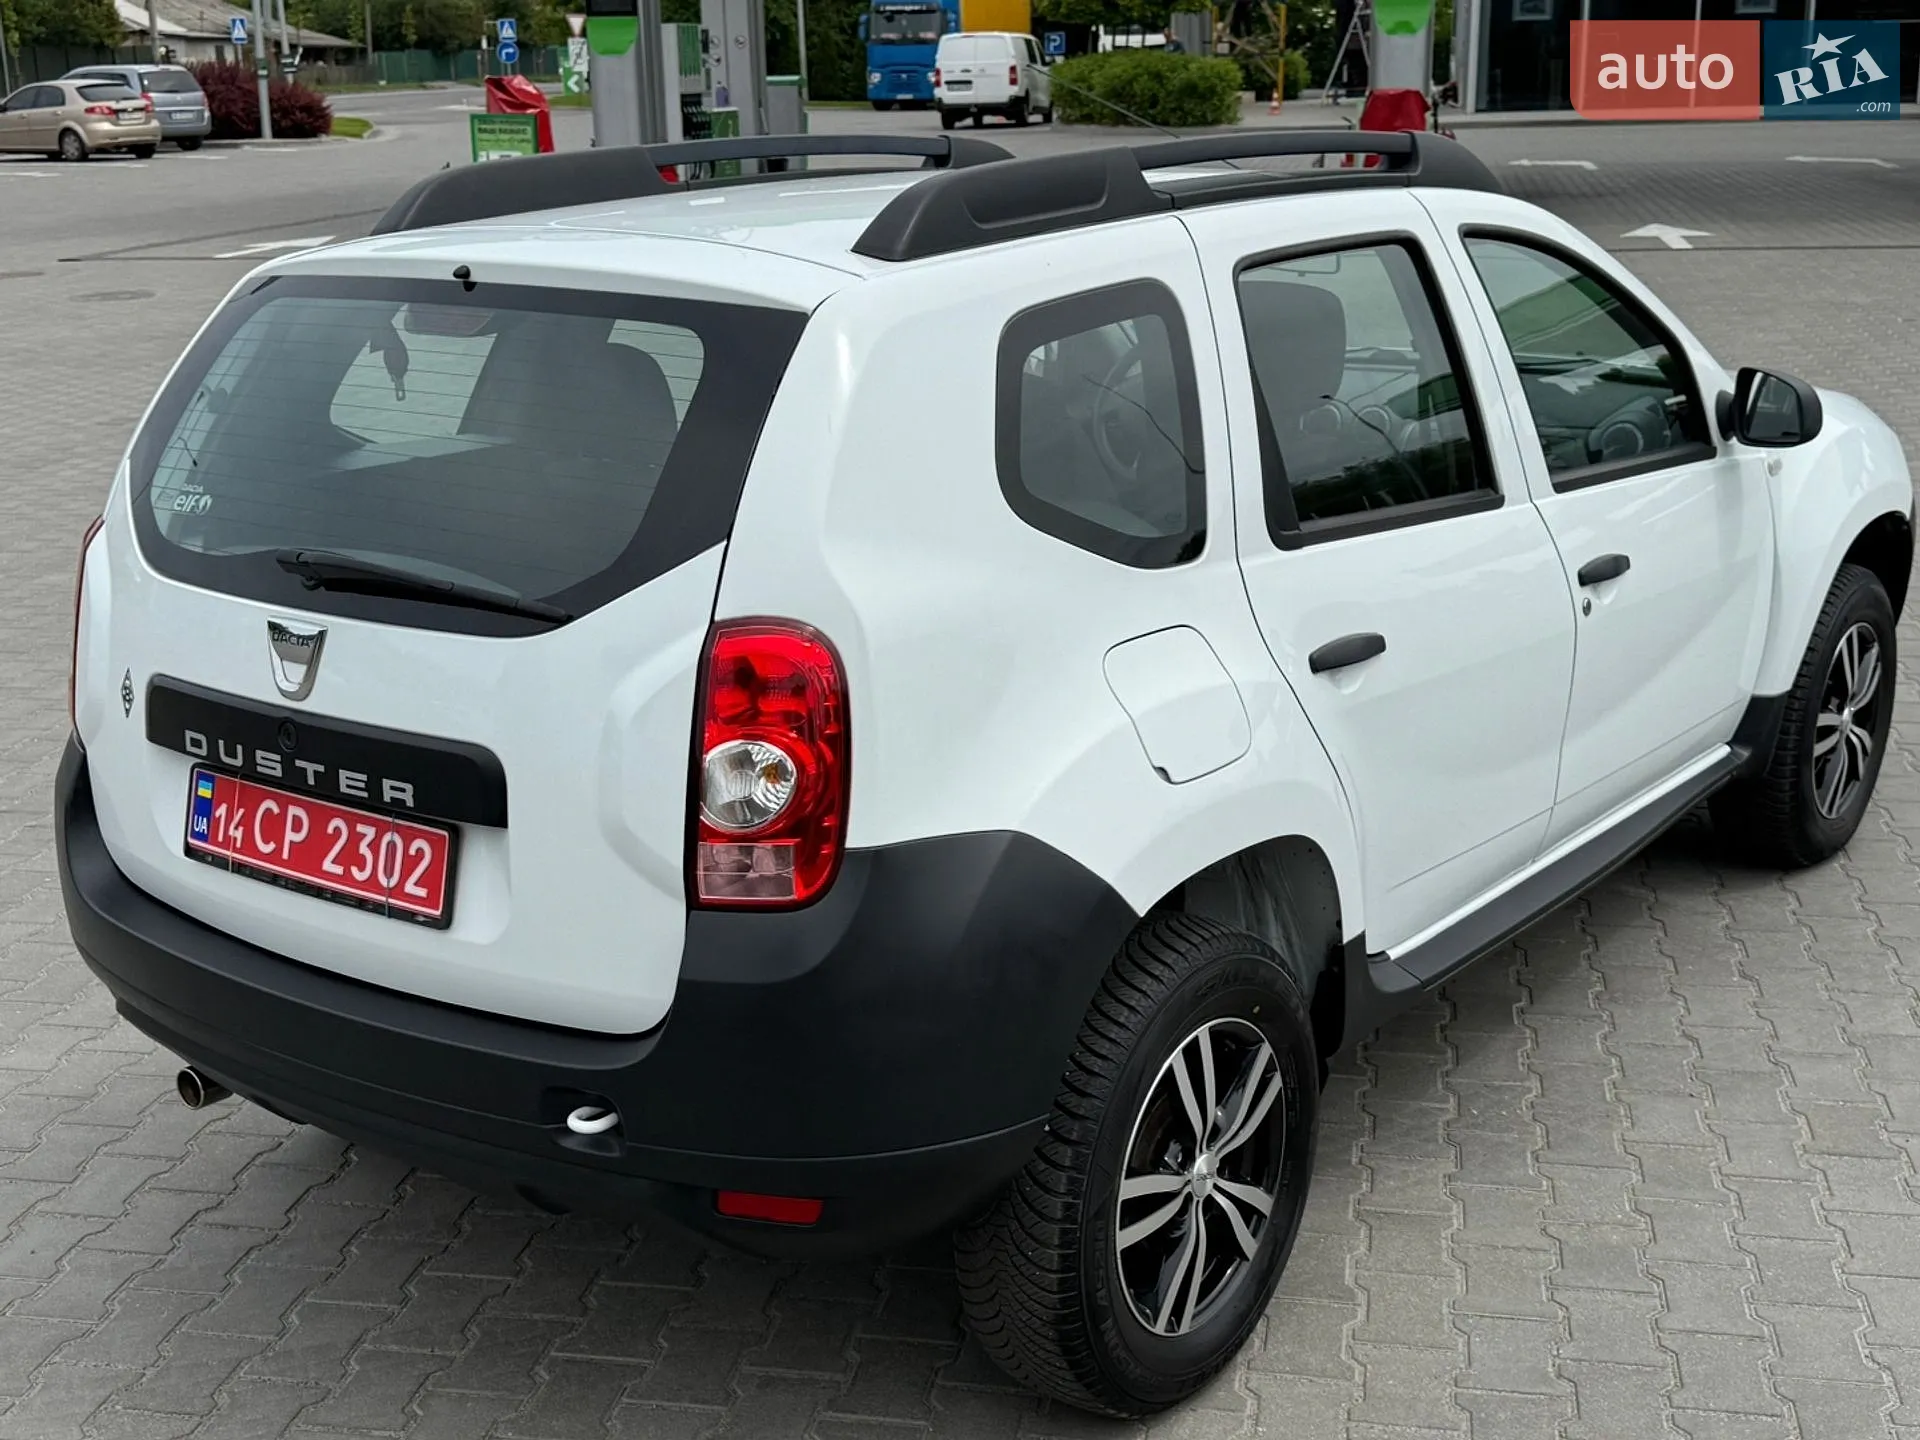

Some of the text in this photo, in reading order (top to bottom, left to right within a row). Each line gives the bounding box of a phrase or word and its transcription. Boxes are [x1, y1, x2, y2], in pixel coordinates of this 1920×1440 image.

[1050, 35, 1061, 52] P
[174, 494, 200, 512] elf
[272, 631, 311, 648] DACIA
[184, 729, 415, 807] DUSTER
[193, 814, 208, 834] UA
[322, 817, 433, 898] 2302
